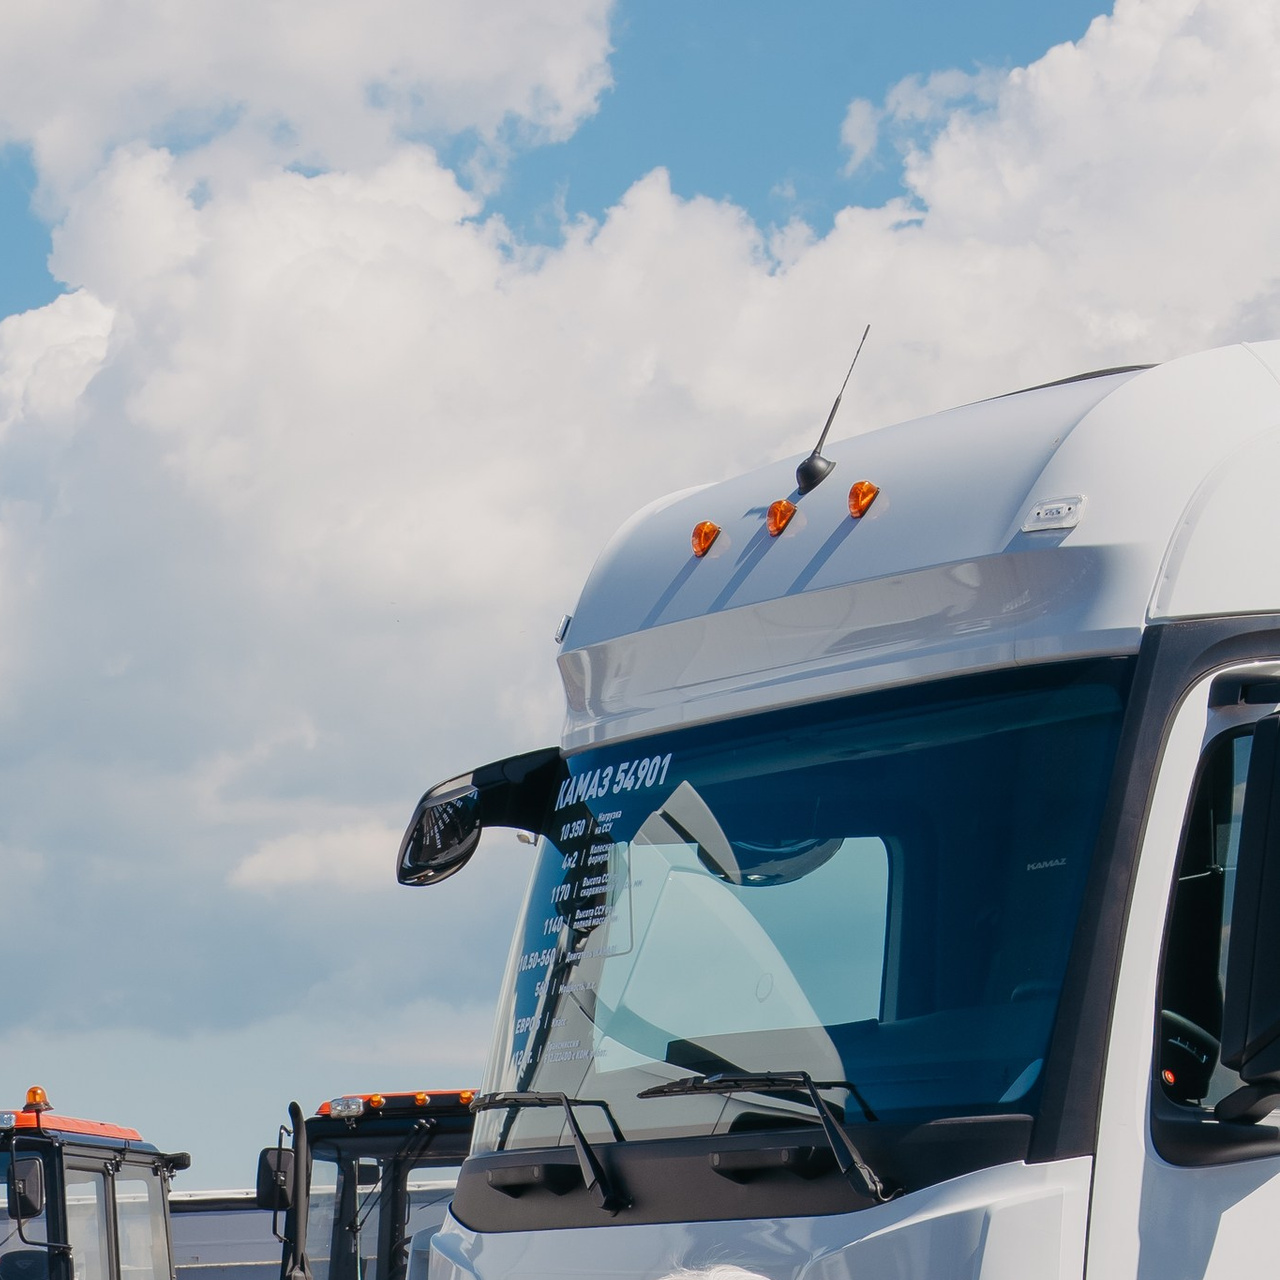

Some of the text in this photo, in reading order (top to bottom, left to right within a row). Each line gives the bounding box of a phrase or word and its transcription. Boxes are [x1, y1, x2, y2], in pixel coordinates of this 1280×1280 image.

[554, 753, 672, 811] КАМАЗ 54901
[598, 810, 622, 823] Нагрузка
[569, 819, 586, 839] 350
[594, 822, 613, 835] на ССУ
[1027, 858, 1067, 871] KAMAZ
[582, 876, 602, 887] Высота
[551, 883, 571, 904] 1170
[575, 908, 595, 919] Высота
[543, 915, 564, 936] 1140
